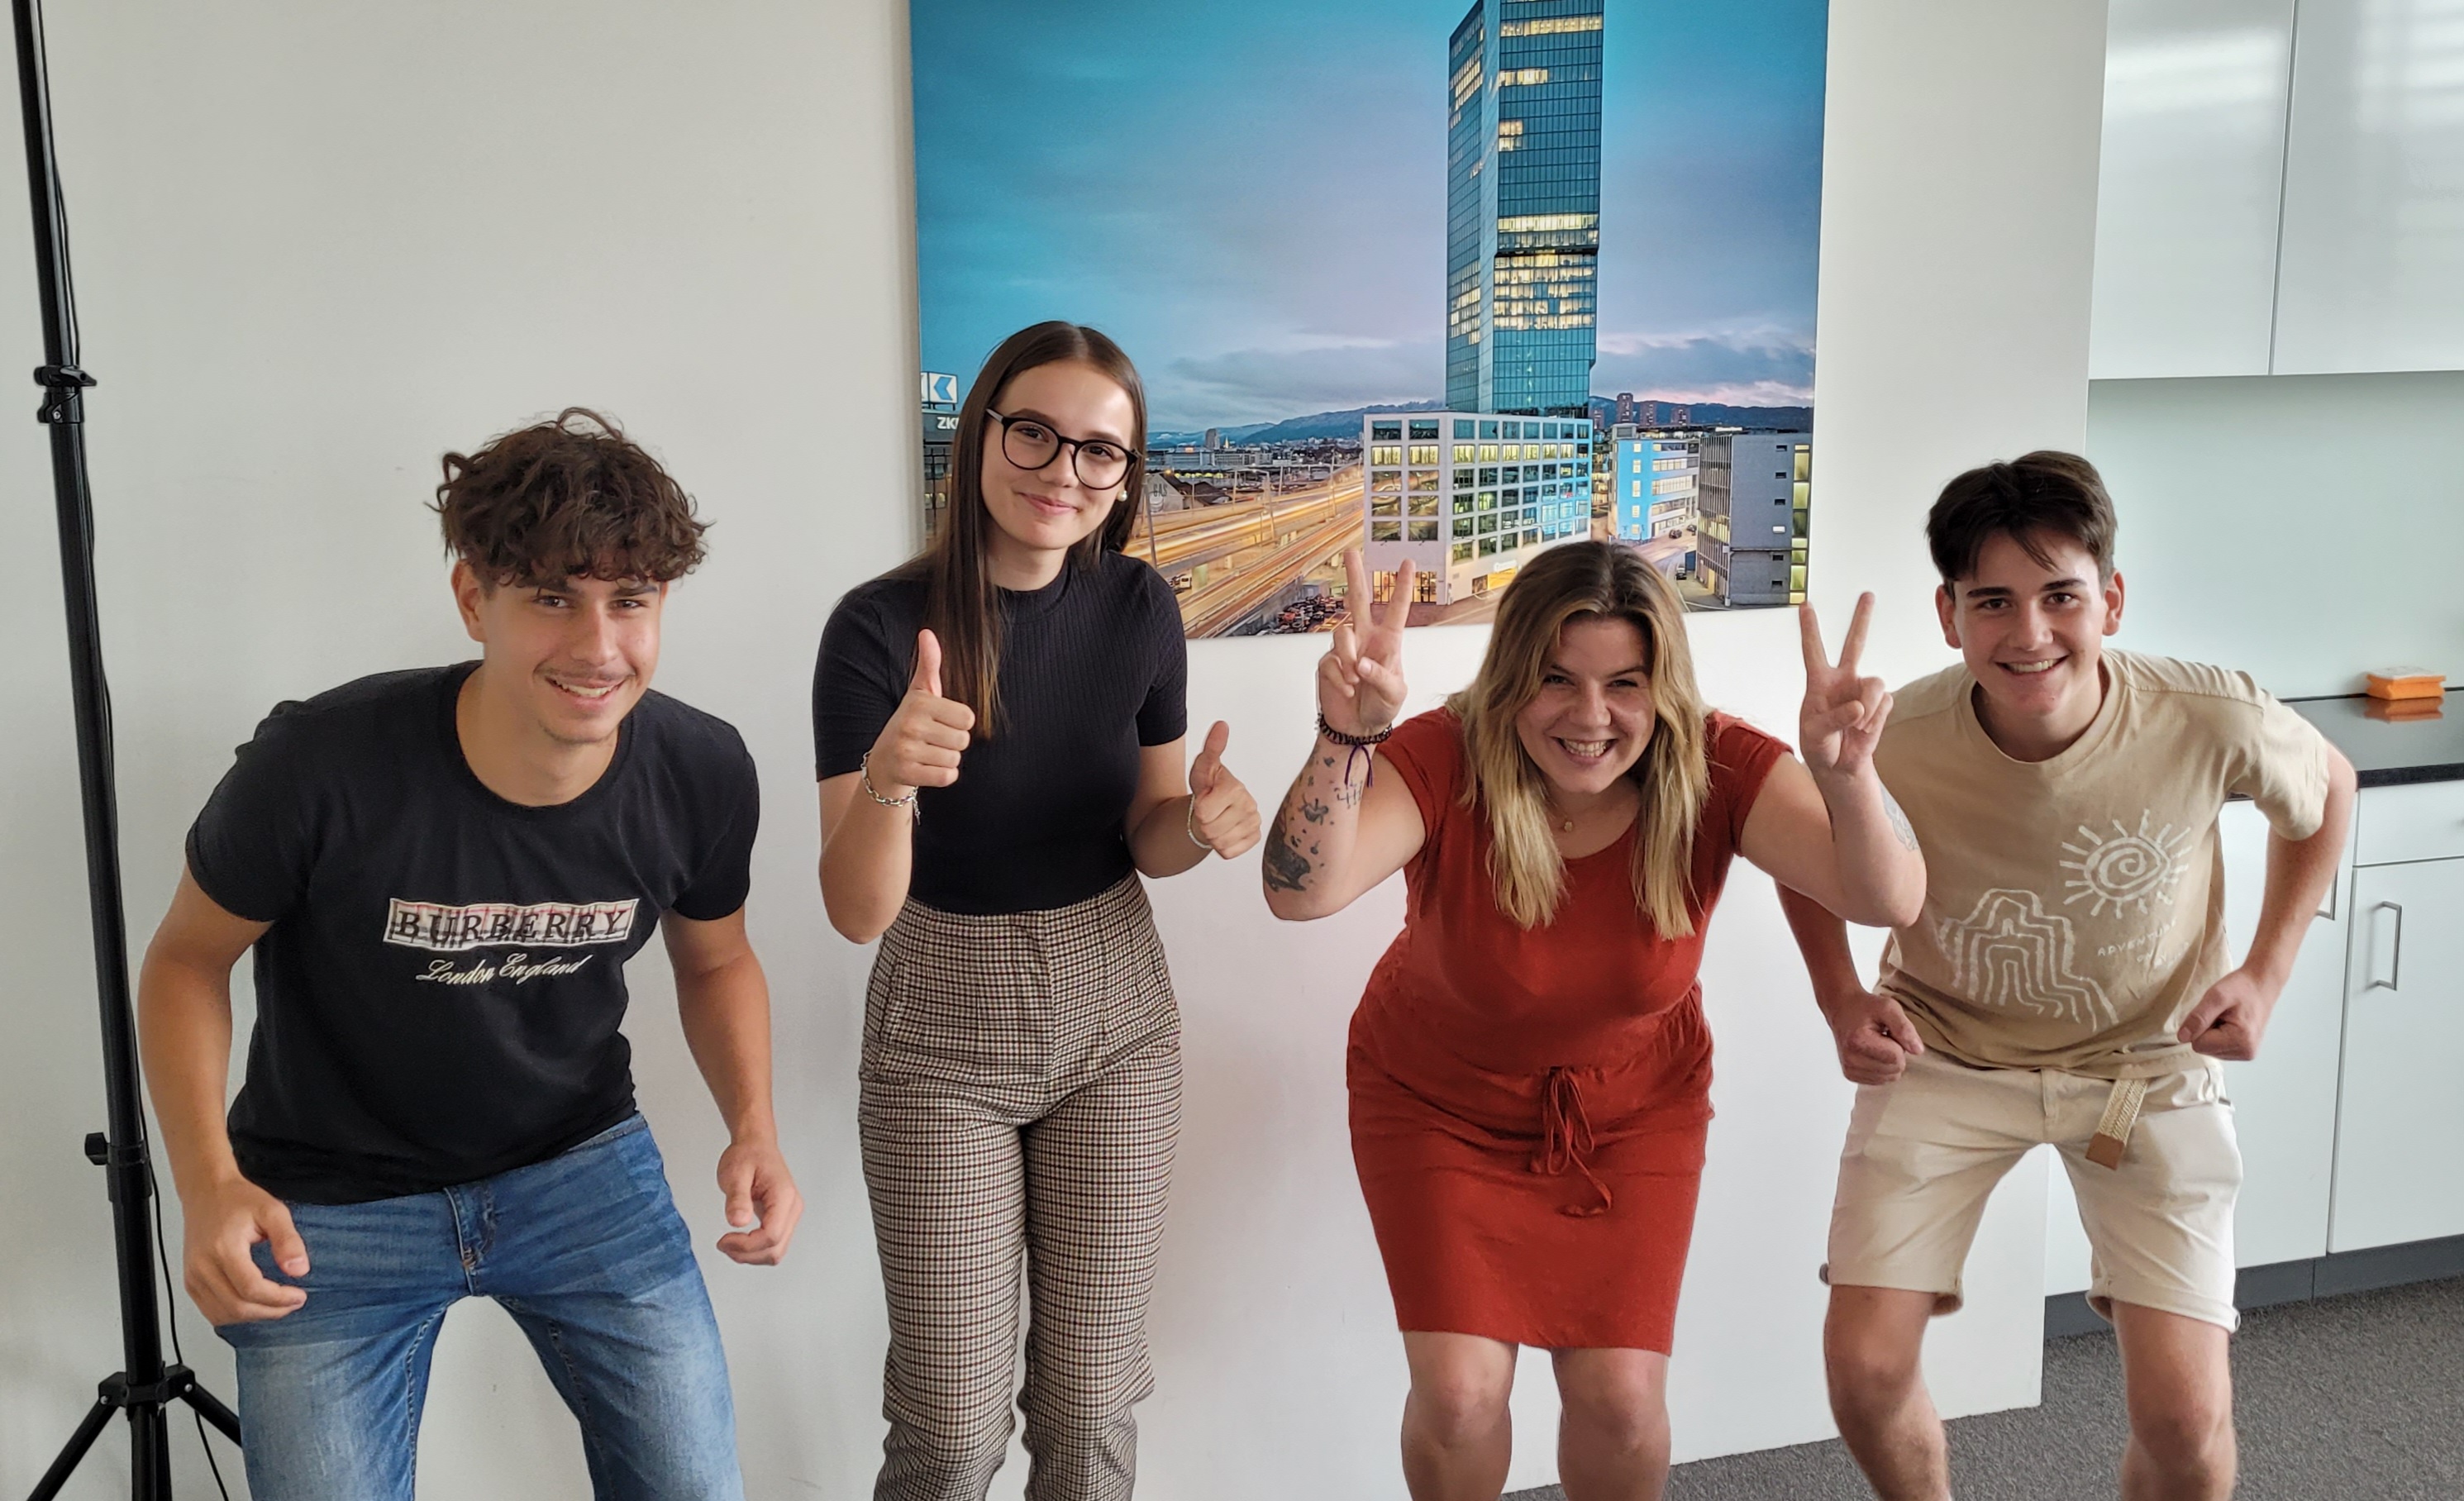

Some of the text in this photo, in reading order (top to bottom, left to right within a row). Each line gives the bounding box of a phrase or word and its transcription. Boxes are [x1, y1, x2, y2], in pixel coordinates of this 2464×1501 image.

[397, 908, 627, 941] BURBERRY
[415, 953, 594, 985] London England
